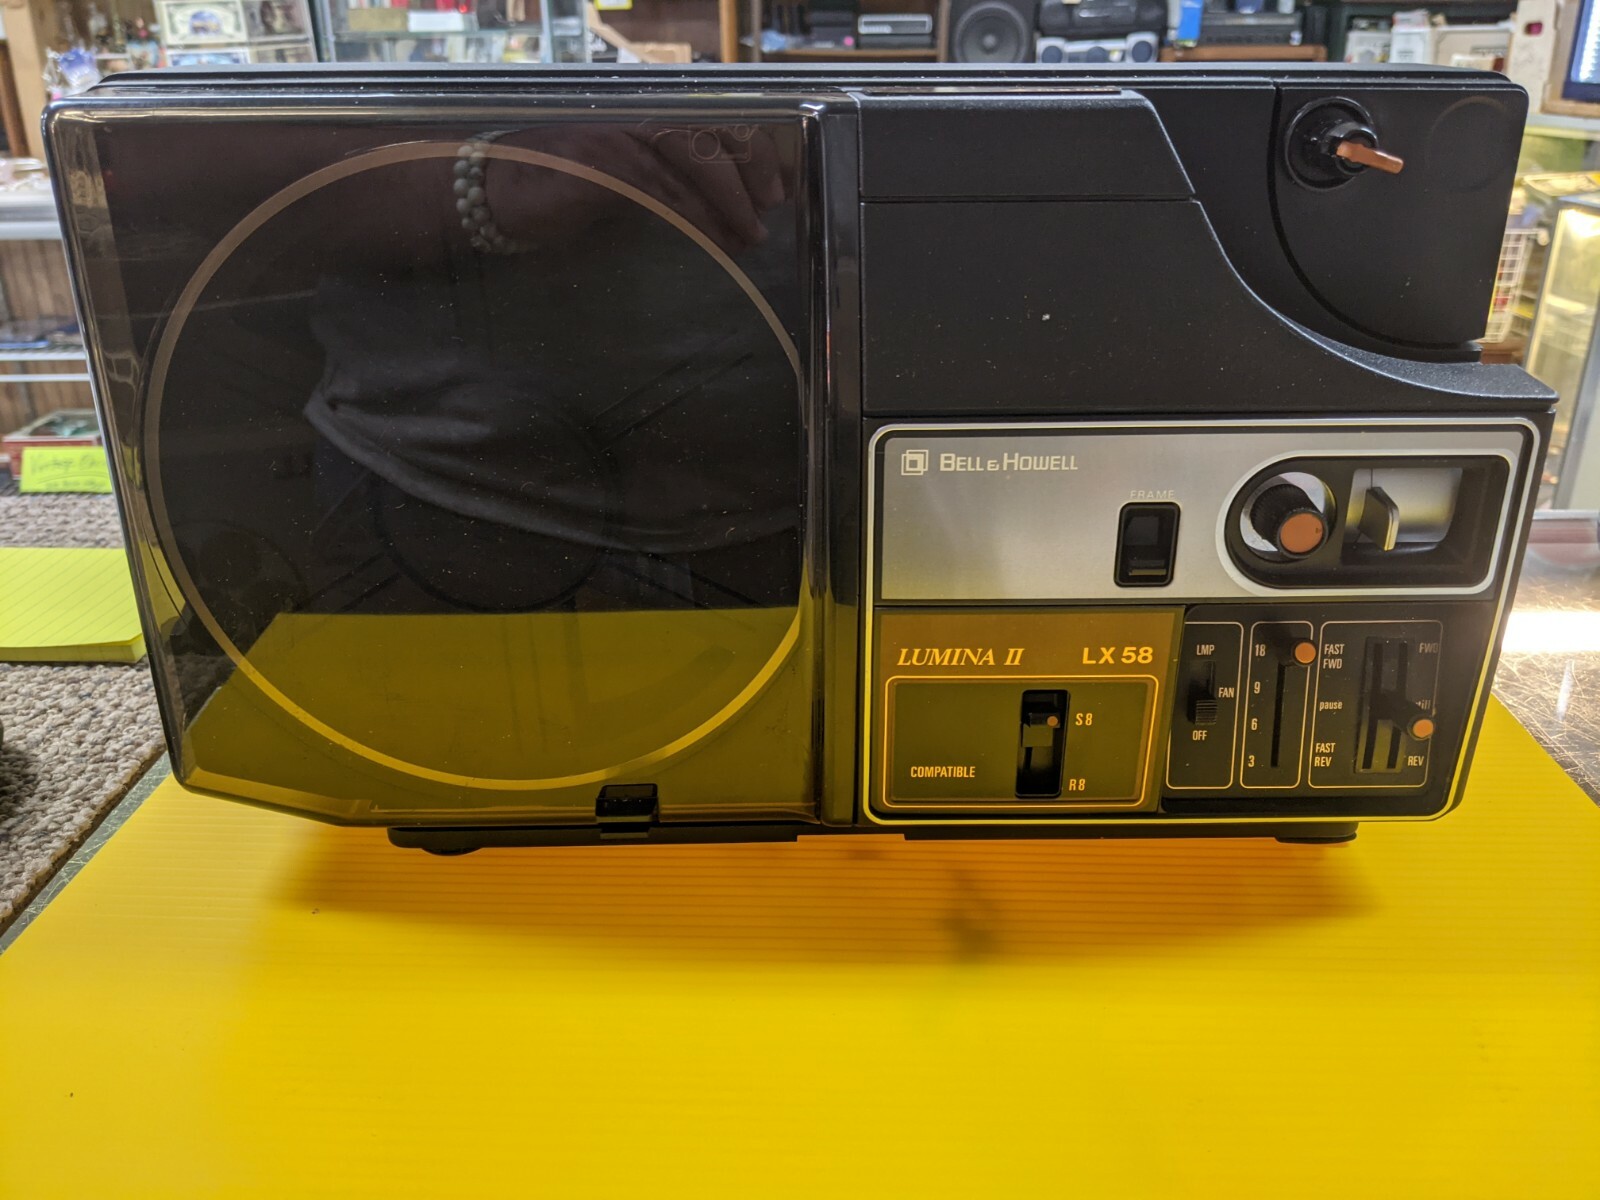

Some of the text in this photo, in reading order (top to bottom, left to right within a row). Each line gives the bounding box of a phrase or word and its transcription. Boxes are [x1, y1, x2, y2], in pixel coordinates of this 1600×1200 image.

[939, 452, 1078, 471] BELL & HOWELL
[1129, 489, 1175, 499] FRAME
[1196, 645, 1215, 656] LMP
[1255, 644, 1266, 657] 18
[1324, 643, 1345, 655] FAST
[1419, 642, 1439, 654] FWD
[897, 648, 1025, 666] LUMINA II
[1082, 646, 1154, 665] LX 58
[1323, 658, 1343, 670] FWD
[1218, 687, 1235, 698] FAN
[1254, 681, 1261, 694] 9
[1319, 701, 1343, 712] pause
[1251, 718, 1258, 731] 6
[1192, 729, 1207, 741] OFF
[1315, 742, 1336, 753] FAST
[1248, 755, 1255, 768] 3
[1314, 756, 1332, 767] REV
[1407, 755, 1424, 767] REV
[910, 766, 976, 778] COMPATIBLE
